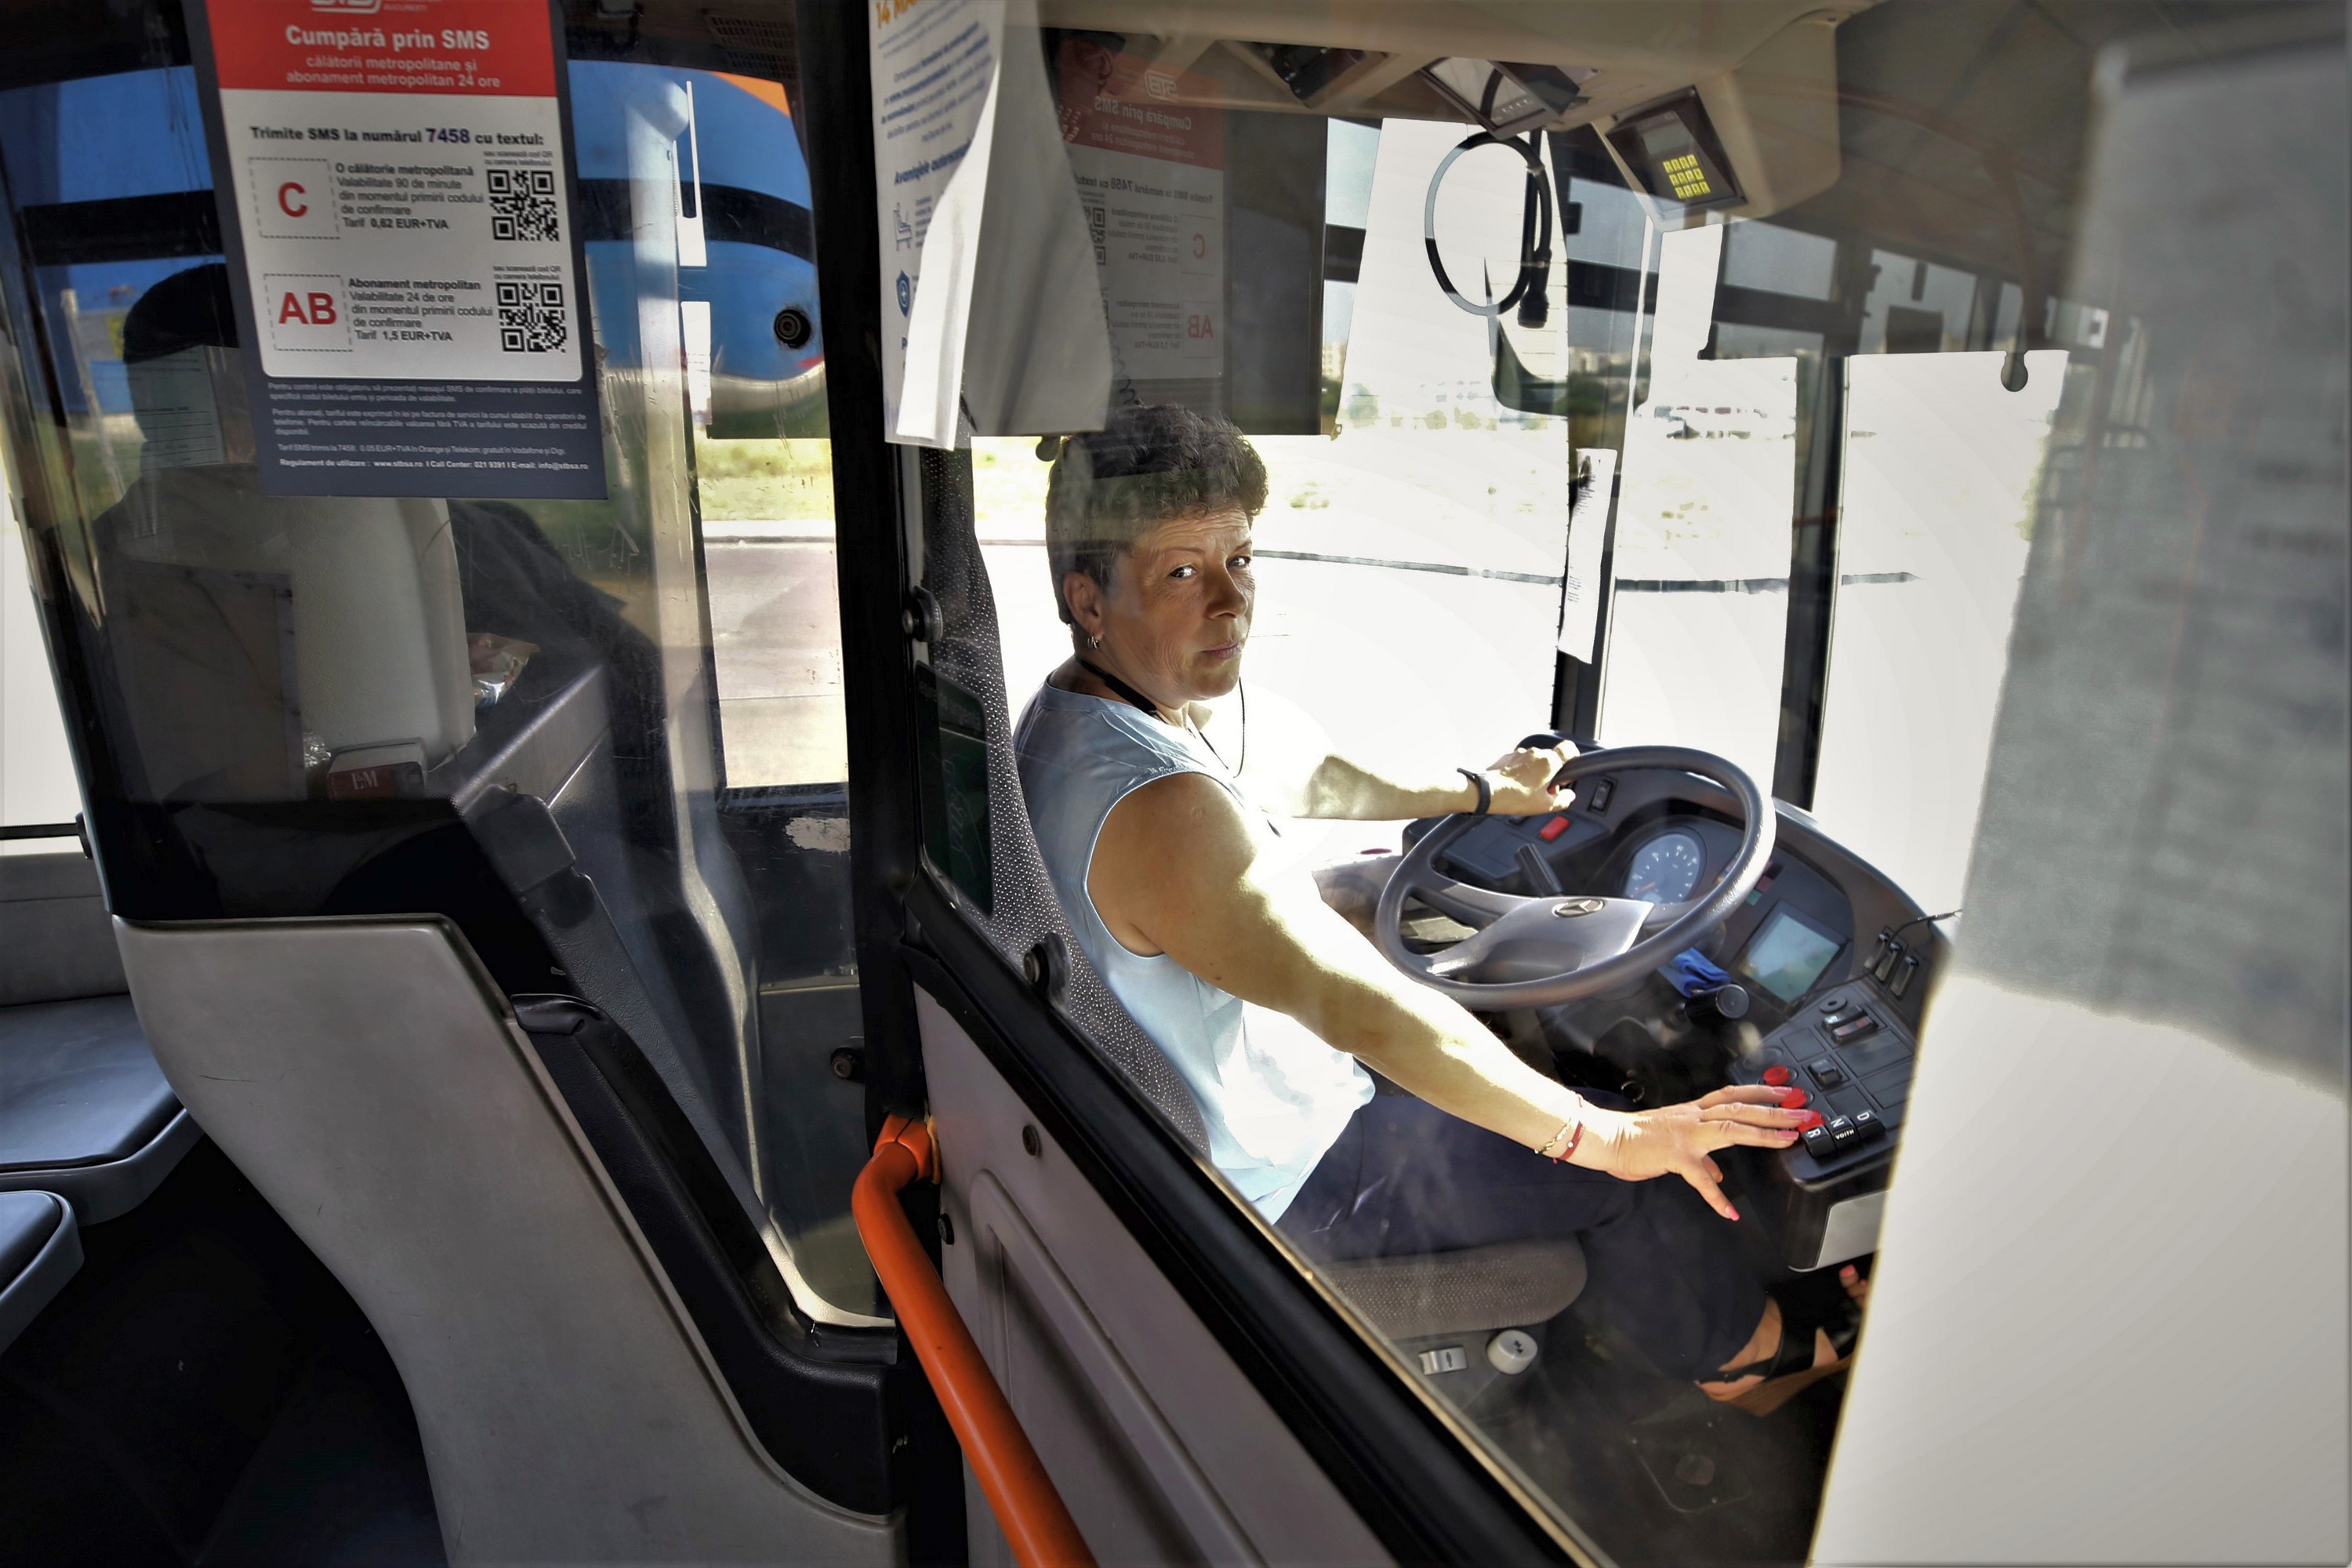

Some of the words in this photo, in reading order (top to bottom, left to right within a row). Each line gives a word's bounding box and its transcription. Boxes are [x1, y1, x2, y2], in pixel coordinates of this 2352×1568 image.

[285, 24, 387, 50] Cumpără
[394, 29, 435, 52] prin
[441, 29, 489, 50] SMS
[306, 56, 362, 68] călătorii
[366, 57, 460, 72] metropolitane
[286, 71, 364, 85] abonament
[368, 72, 455, 87] metropolitan
[459, 74, 474, 86] 24
[478, 78, 500, 87] ore
[250, 126, 303, 140] Trimite
[308, 128, 339, 140] SMS
[345, 129, 358, 140] la
[362, 130, 422, 142] numărul
[425, 128, 470, 143] 7458
[475, 134, 492, 144] cu
[497, 132, 544, 145] textul:
[335, 163, 345, 172] O
[347, 164, 395, 174] călătorie
[398, 165, 474, 177] metropolitană
[337, 177, 392, 187] Valabilitate
[395, 178, 408, 187] 90
[412, 179, 425, 188] de
[427, 180, 462, 189] minute
[278, 181, 308, 218] C
[339, 191, 355, 201] din
[358, 191, 408, 201] momentul
[411, 193, 445, 204] primirii
[448, 193, 484, 203] codului
[341, 205, 354, 214] de
[358, 205, 411, 216] confirmare
[343, 216, 365, 227] Tarif
[371, 217, 393, 229] 0,62
[396, 218, 449, 229] EUR+TVA
[348, 278, 411, 289] Abonament
[413, 280, 481, 292] metropolitan
[350, 291, 404, 301] Valabilitate
[407, 292, 419, 302] 24
[423, 292, 435, 302] de
[278, 292, 337, 325] AB
[351, 305, 366, 314] din
[370, 305, 419, 315] momentul
[422, 307, 454, 317] primirii
[457, 307, 493, 316] codului
[354, 318, 366, 327] de
[369, 318, 422, 328] confirmare
[354, 329, 376, 339] Tarif
[383, 331, 398, 341] 1,5
[401, 331, 453, 341] EUR+TVA
[1857, 1112, 1870, 1121] D
[1831, 1118, 1845, 1128] N
[1807, 1128, 1821, 1138] R
[1835, 1129, 1855, 1140] VOITH
